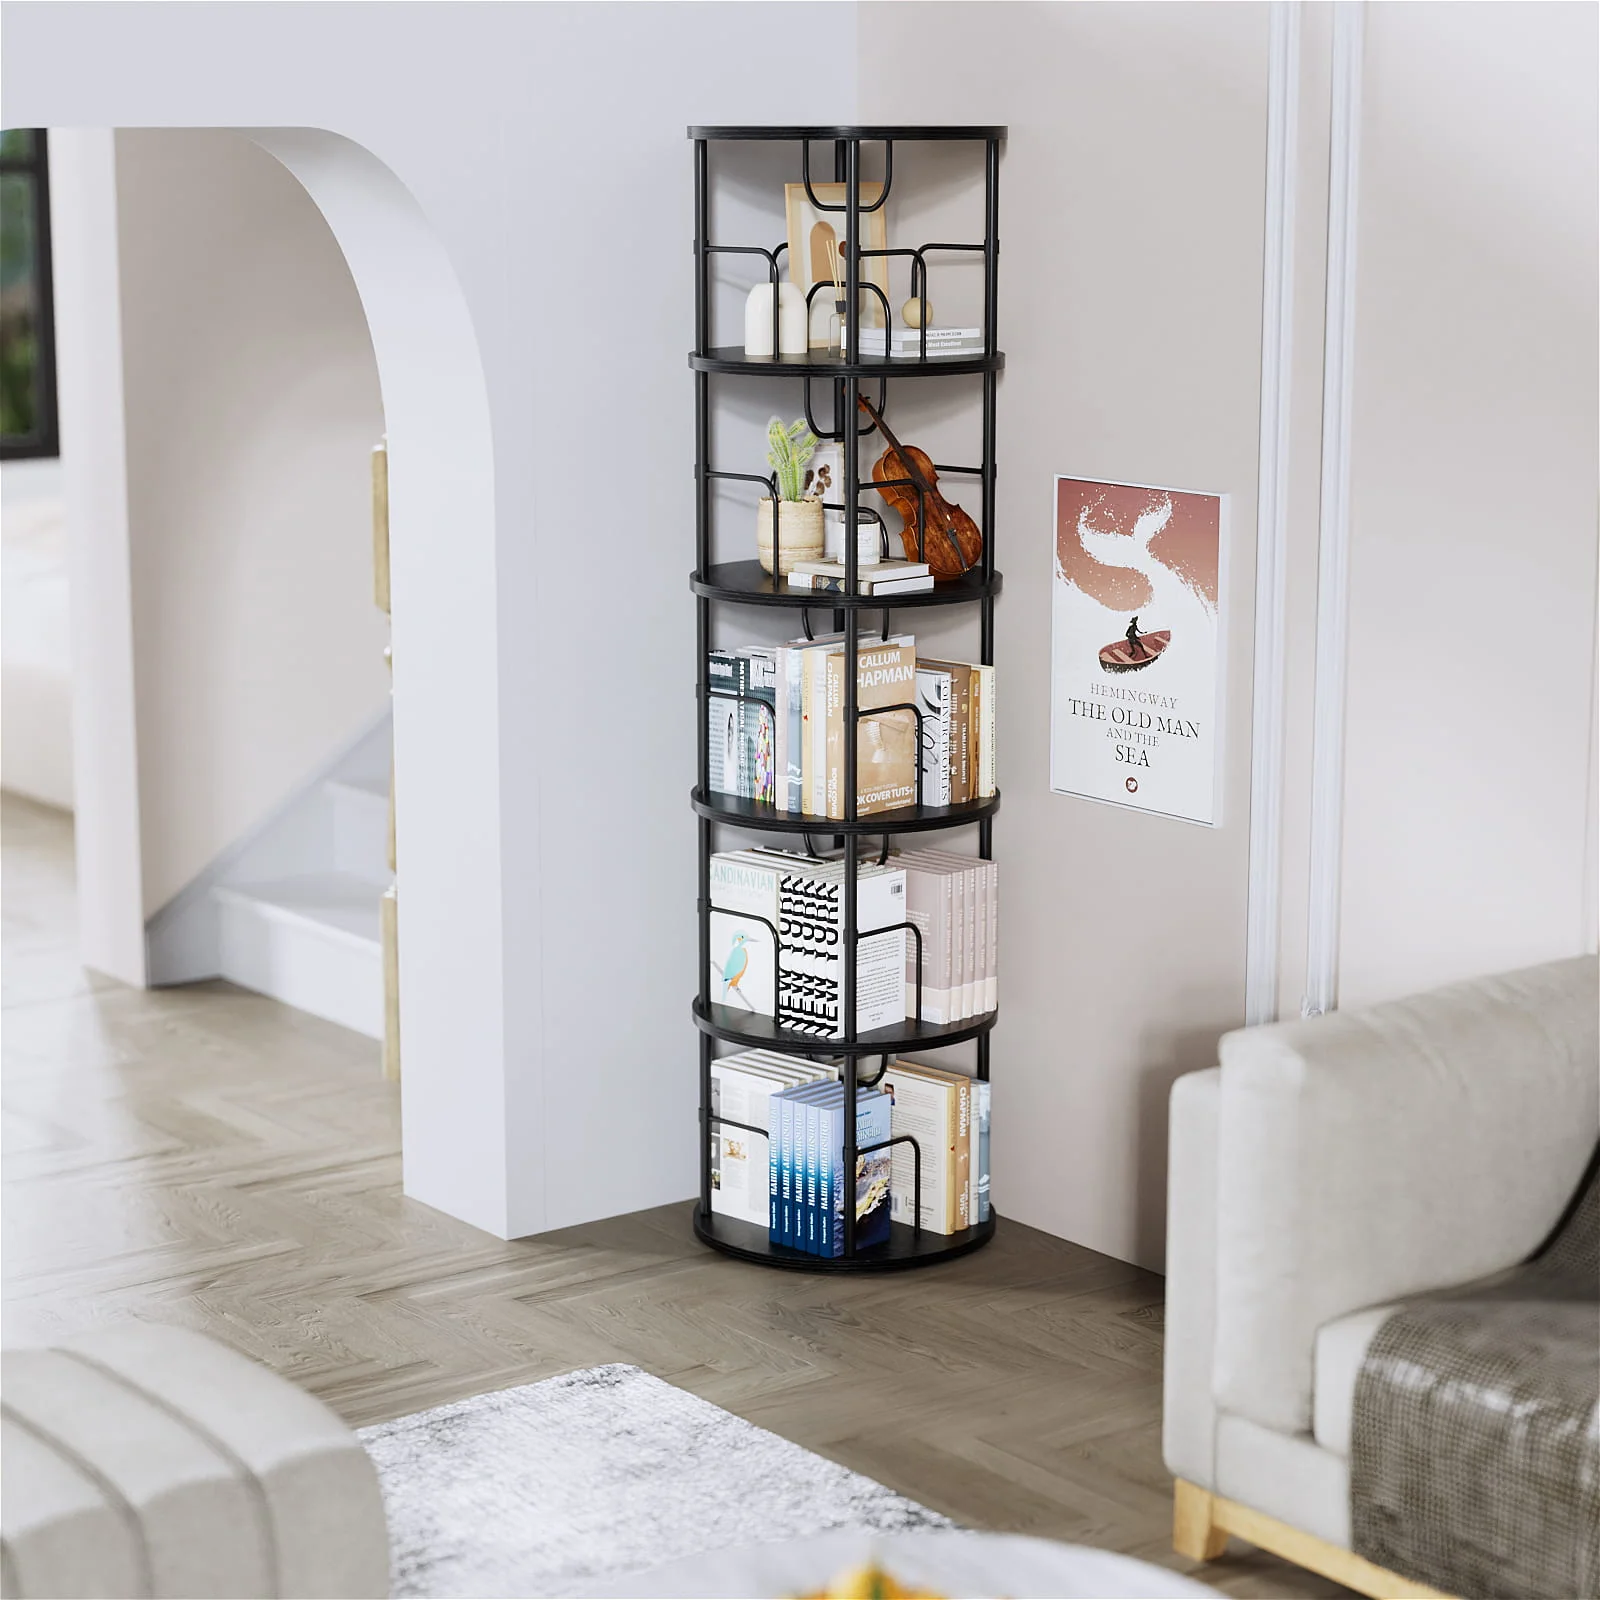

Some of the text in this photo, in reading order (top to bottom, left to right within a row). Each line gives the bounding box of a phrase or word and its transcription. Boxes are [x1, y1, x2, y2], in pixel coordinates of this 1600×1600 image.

[857, 665, 913, 688] HAPMAN
[859, 651, 900, 669] CALLUM
[1091, 683, 1178, 709] HEMINGWAY
[1069, 698, 1200, 739] THE OLD MAN
[1106, 727, 1160, 747] AND THE
[941, 686, 949, 801] OLIVER PEOPLES
[1115, 744, 1151, 768] SEA
[866, 790, 891, 803] COVER
[891, 785, 914, 798] TUTS+
[710, 863, 775, 892] ANDINAVIAN
[779, 876, 792, 1028] NEW YORK
[791, 878, 804, 1030] NEW YORK
[803, 880, 815, 1033] NEW YORK
[814, 882, 827, 1036] NEW YORK
[826, 884, 839, 1038] NEW YORK
[959, 1087, 967, 1137] CHAPMAN
